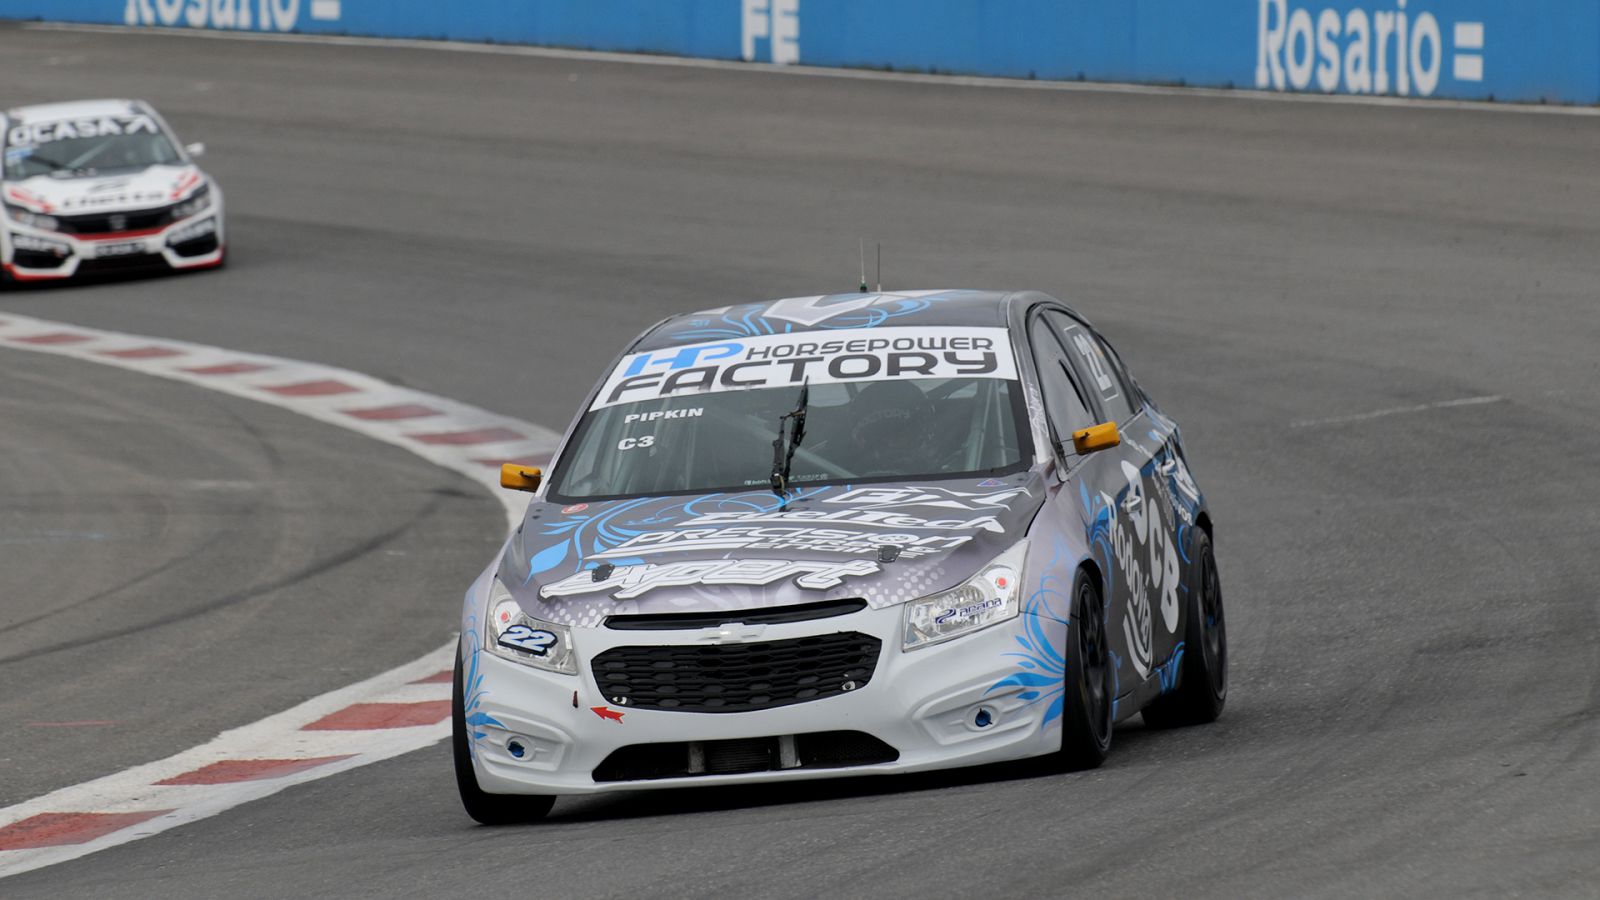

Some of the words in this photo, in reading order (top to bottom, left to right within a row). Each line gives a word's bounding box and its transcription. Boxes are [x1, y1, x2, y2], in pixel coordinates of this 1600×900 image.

[742, 0, 799, 63] FE
[1256, 0, 1442, 96] Rosario
[9, 118, 122, 146] OCASA
[623, 342, 745, 377] HP
[745, 336, 994, 361] HORSEPOWER
[605, 351, 998, 404] FACTORY
[624, 407, 704, 424] PIPKIN
[617, 435, 655, 450] C3
[498, 624, 558, 656] 22
